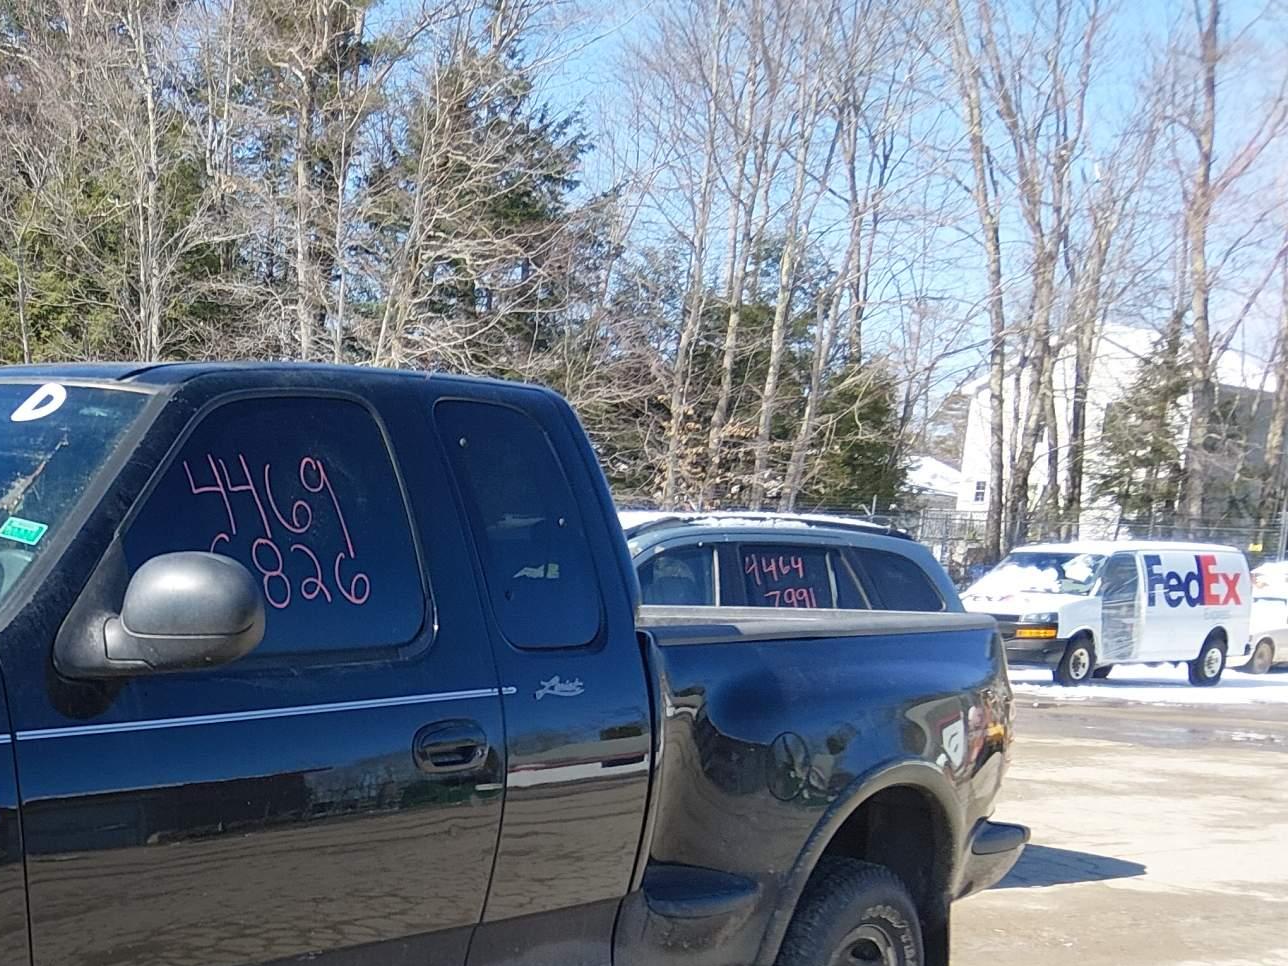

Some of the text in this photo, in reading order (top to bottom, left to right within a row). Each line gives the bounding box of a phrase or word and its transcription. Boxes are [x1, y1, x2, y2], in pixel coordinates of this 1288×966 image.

[182, 453, 357, 559] 4469
[209, 531, 372, 610] 826
[744, 553, 805, 586] 4464
[1143, 554, 1242, 608] FedEx
